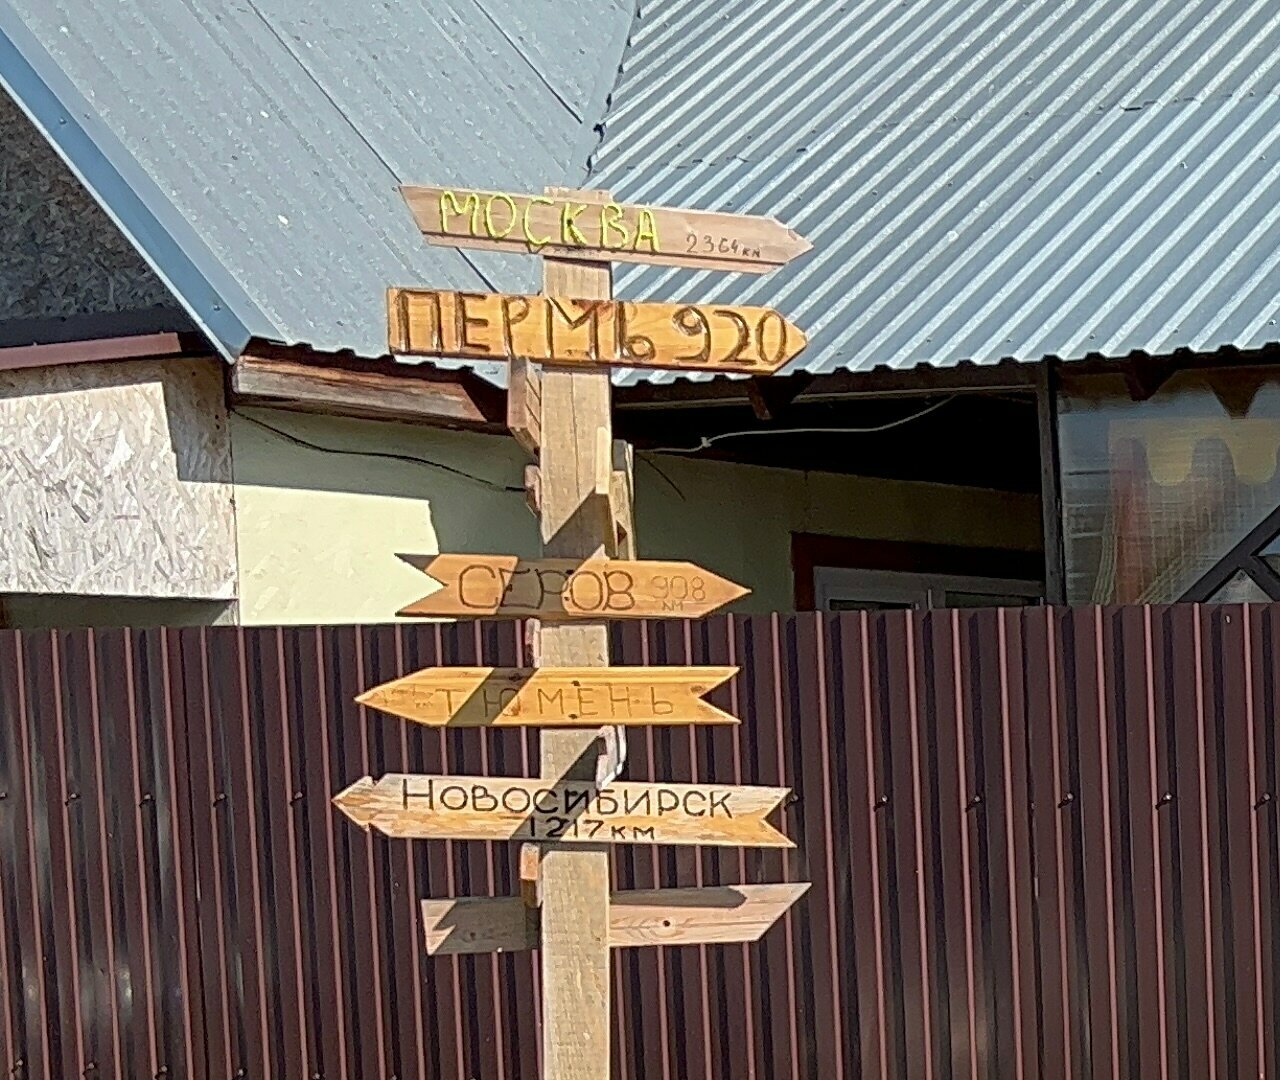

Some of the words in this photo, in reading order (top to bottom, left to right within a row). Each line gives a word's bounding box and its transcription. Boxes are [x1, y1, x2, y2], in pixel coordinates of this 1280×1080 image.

[438, 190, 661, 253] МОСКВА
[397, 290, 656, 362] ПЕРМЬ
[673, 306, 788, 364] 920
[459, 564, 635, 612] СЕРОВ
[650, 575, 706, 601] 908
[435, 682, 675, 718] ТЮМЕНЬ
